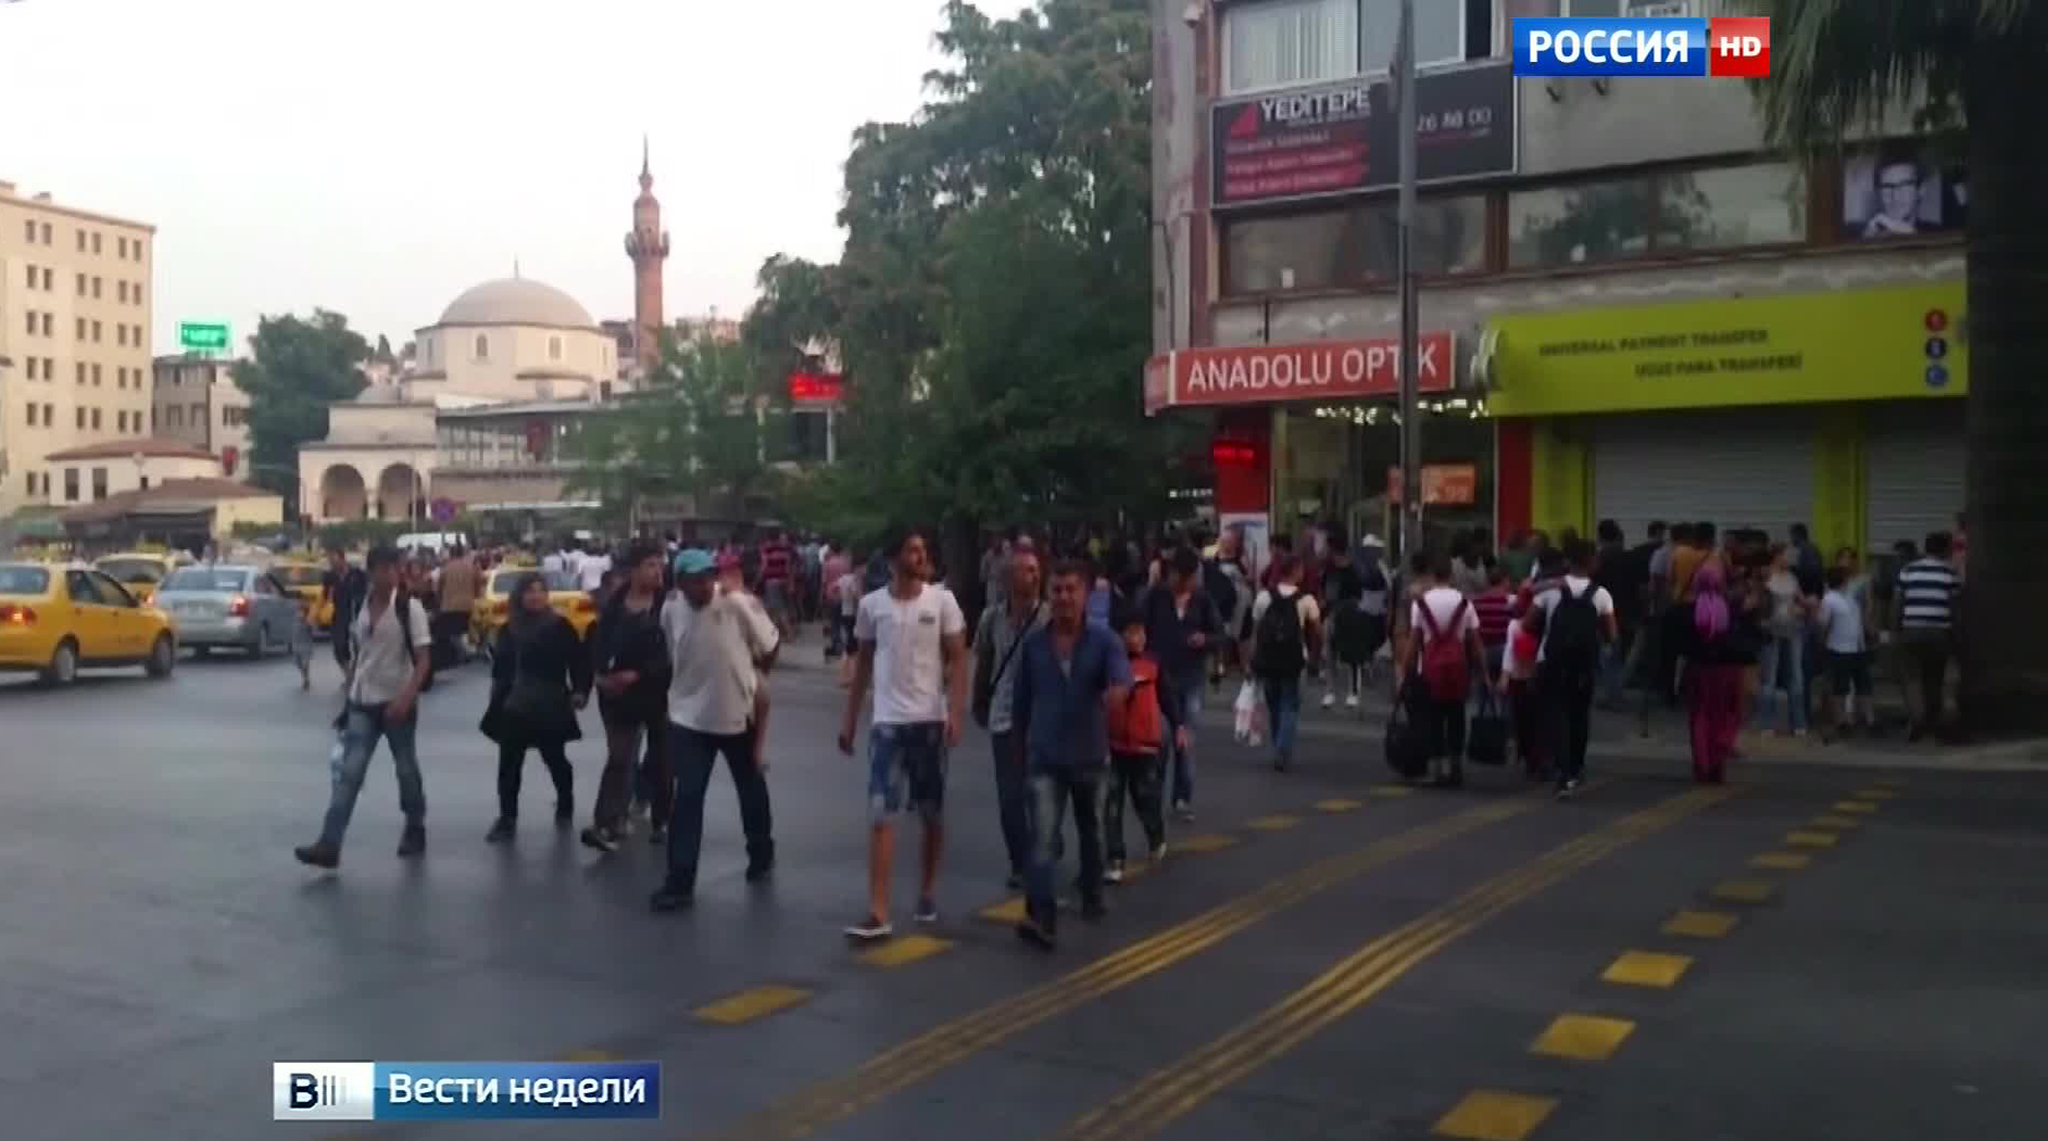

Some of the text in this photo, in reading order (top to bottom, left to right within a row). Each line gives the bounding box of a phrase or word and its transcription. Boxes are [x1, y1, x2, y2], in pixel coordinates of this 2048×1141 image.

[1693, 327, 1769, 346] TRANSFER
[1186, 341, 1438, 394] ANADOLU OPTK
